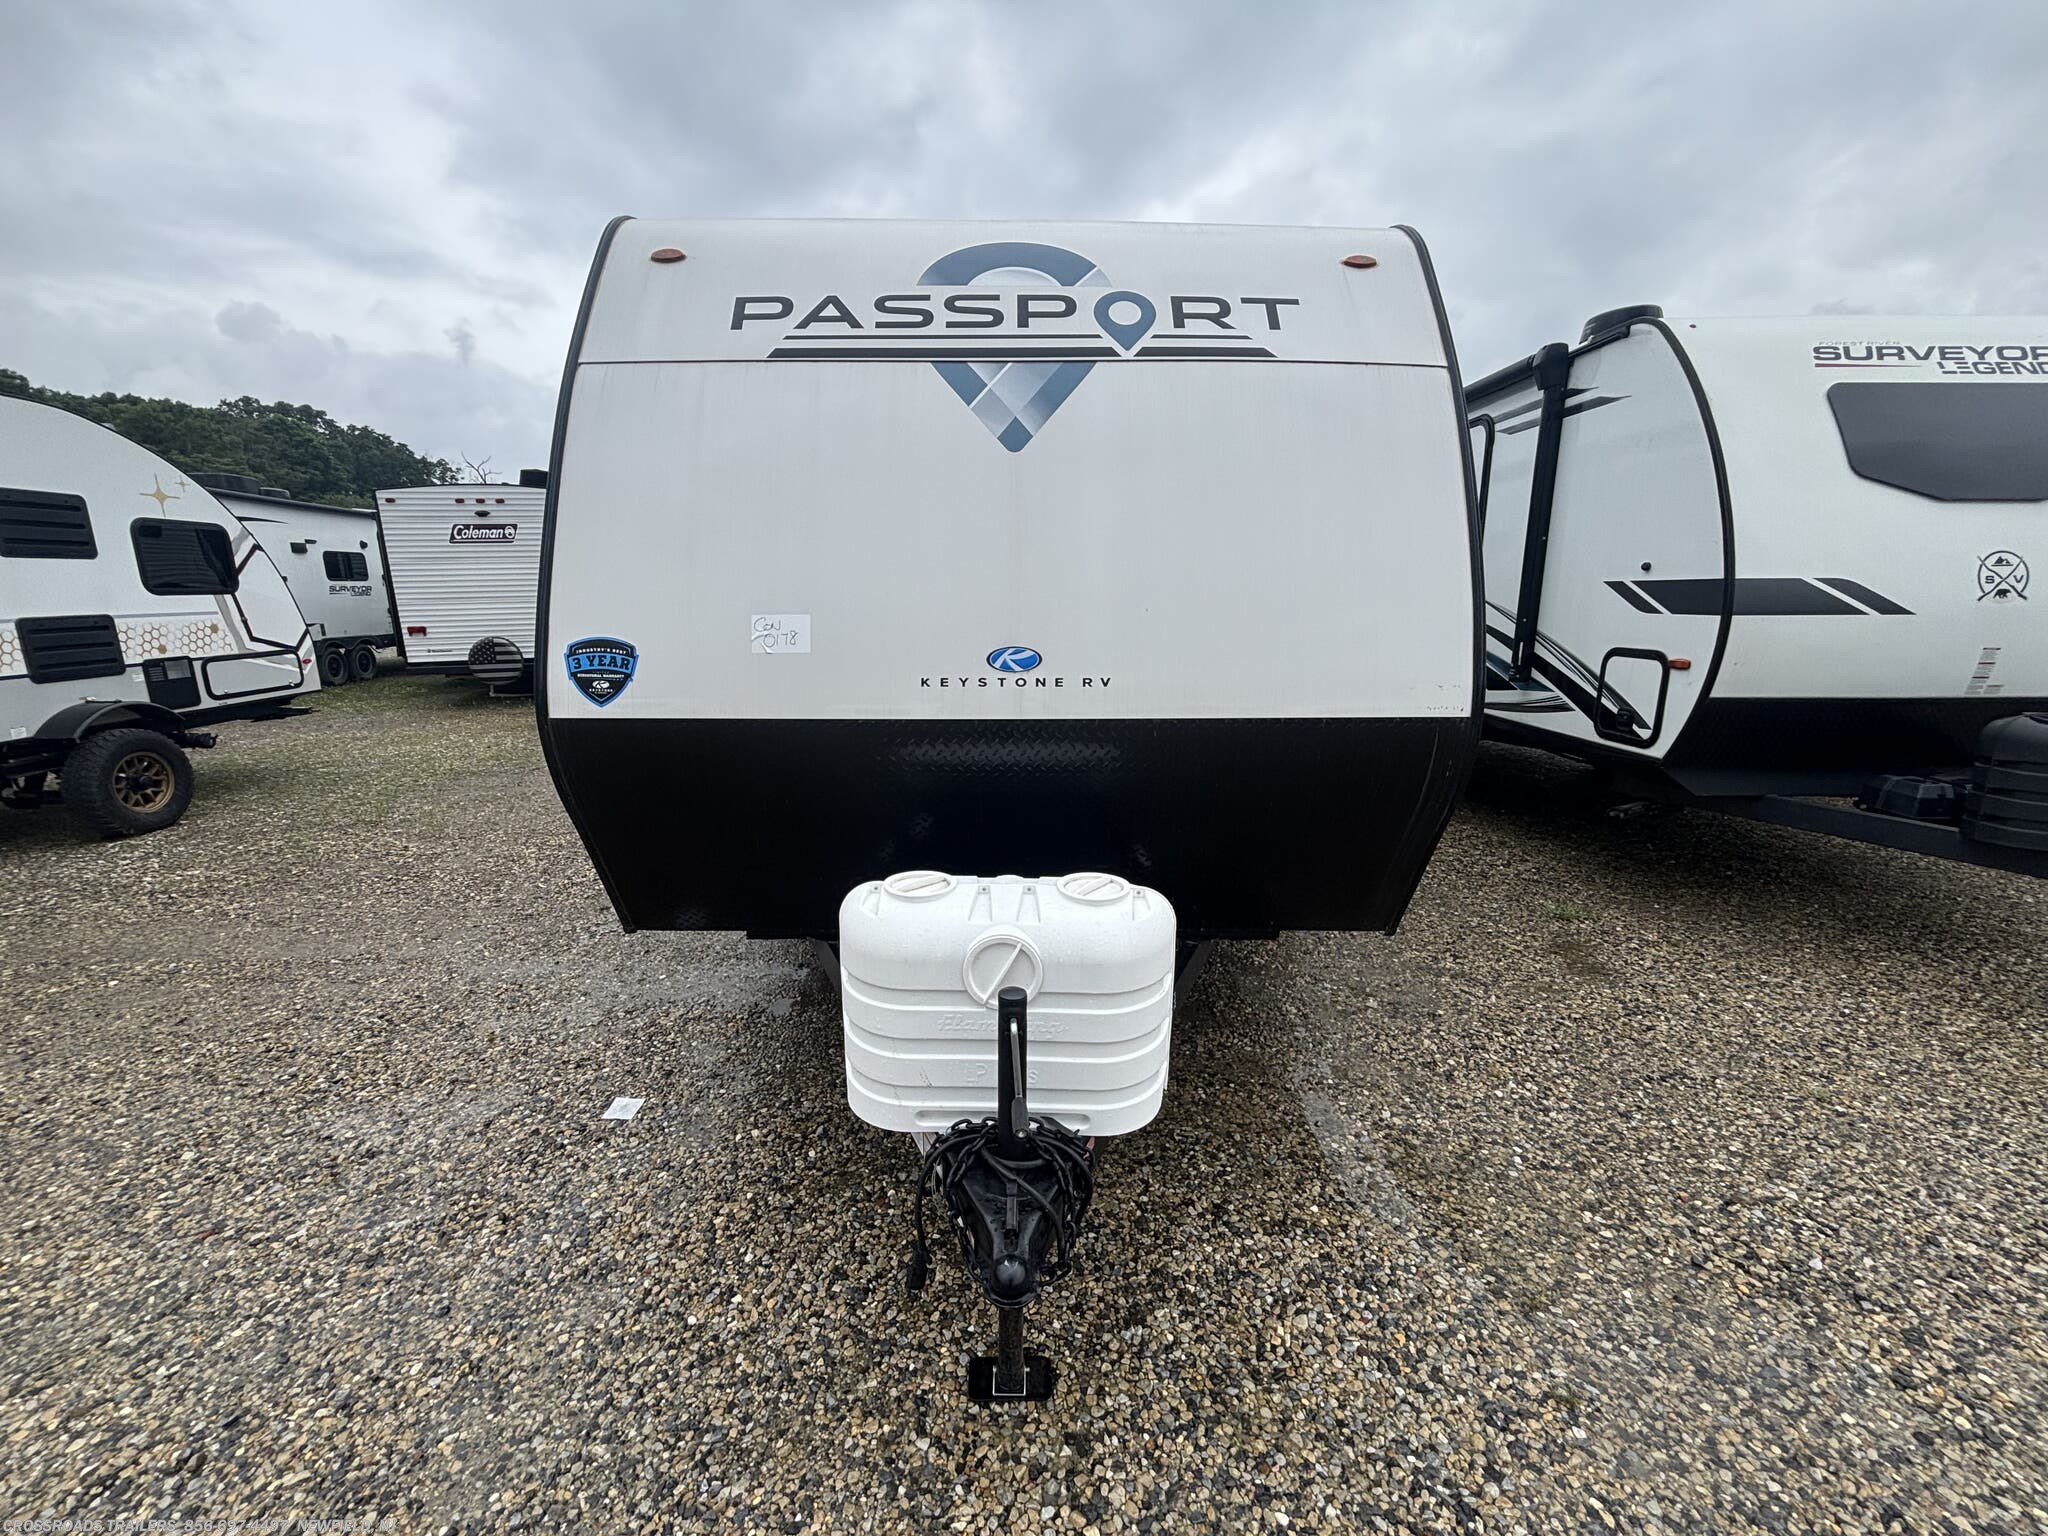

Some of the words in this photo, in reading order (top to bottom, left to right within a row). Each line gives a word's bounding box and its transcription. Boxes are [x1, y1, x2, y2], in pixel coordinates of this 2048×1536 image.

[730, 290, 1300, 346] PASSPORT
[453, 525, 504, 539] Coleman
[572, 657, 582, 670] 3
[585, 655, 631, 670] YEAR
[920, 677, 1064, 688] KEYSTONE
[1082, 677, 1112, 688] RV
